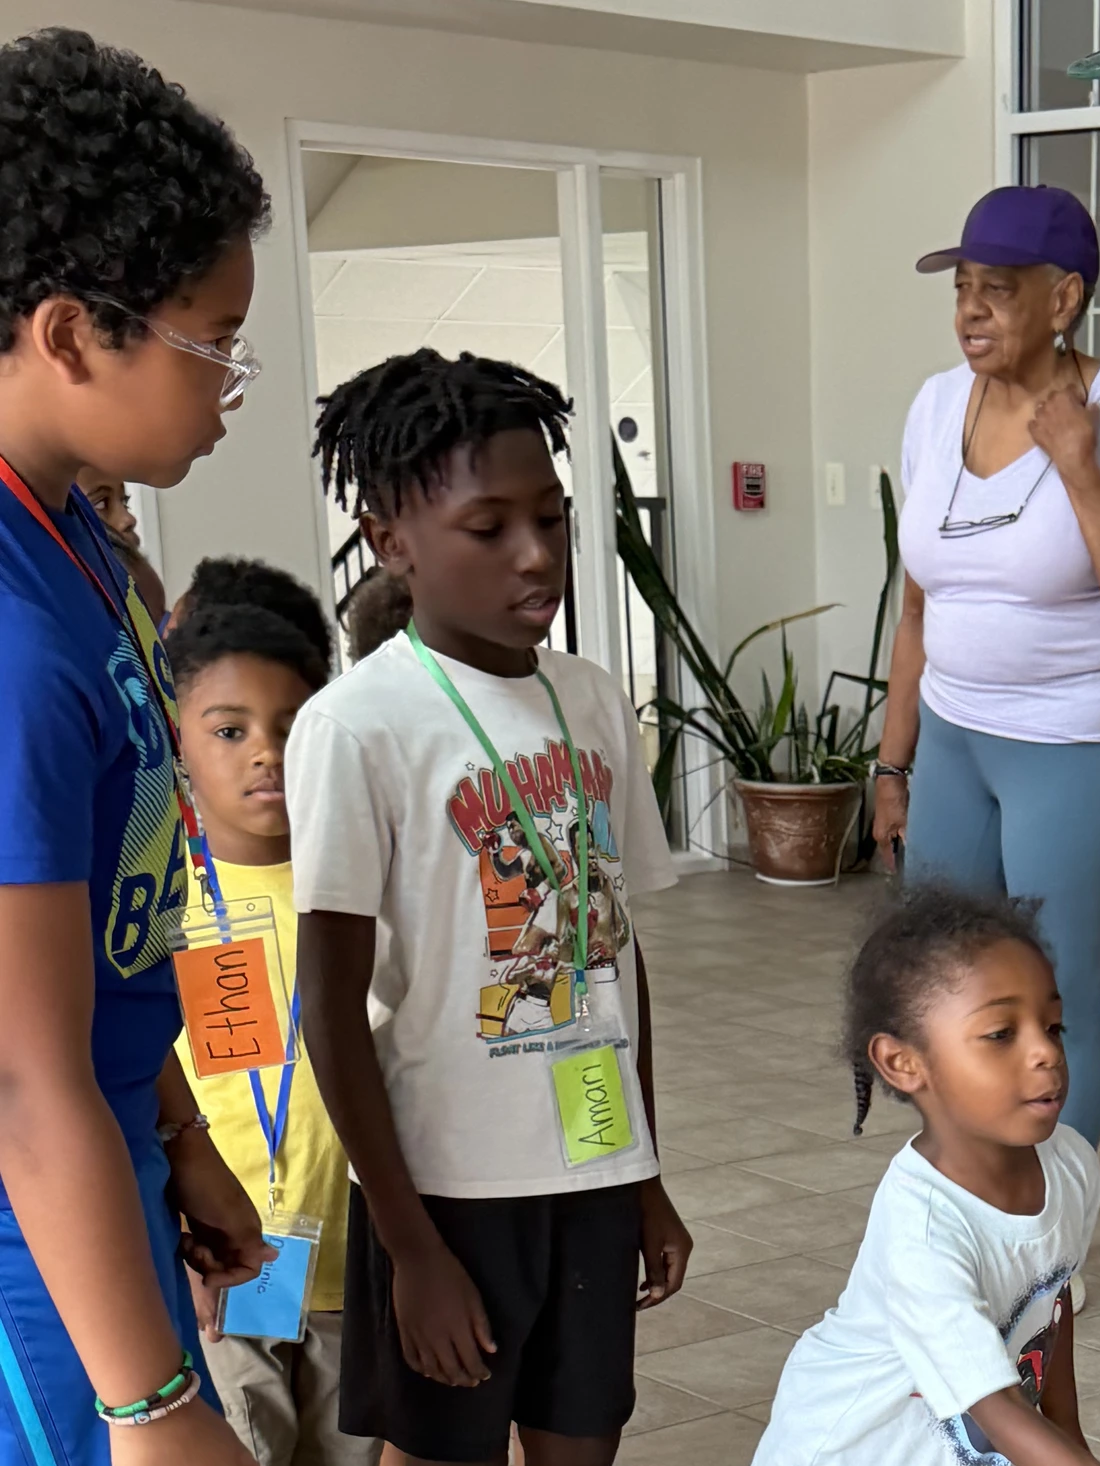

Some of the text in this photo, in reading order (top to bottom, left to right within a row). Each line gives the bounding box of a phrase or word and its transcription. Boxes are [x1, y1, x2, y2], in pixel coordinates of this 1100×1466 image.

[203, 949, 261, 1060] Ethan
[578, 1063, 616, 1147] Amari
[258, 1234, 285, 1295] Dinic
